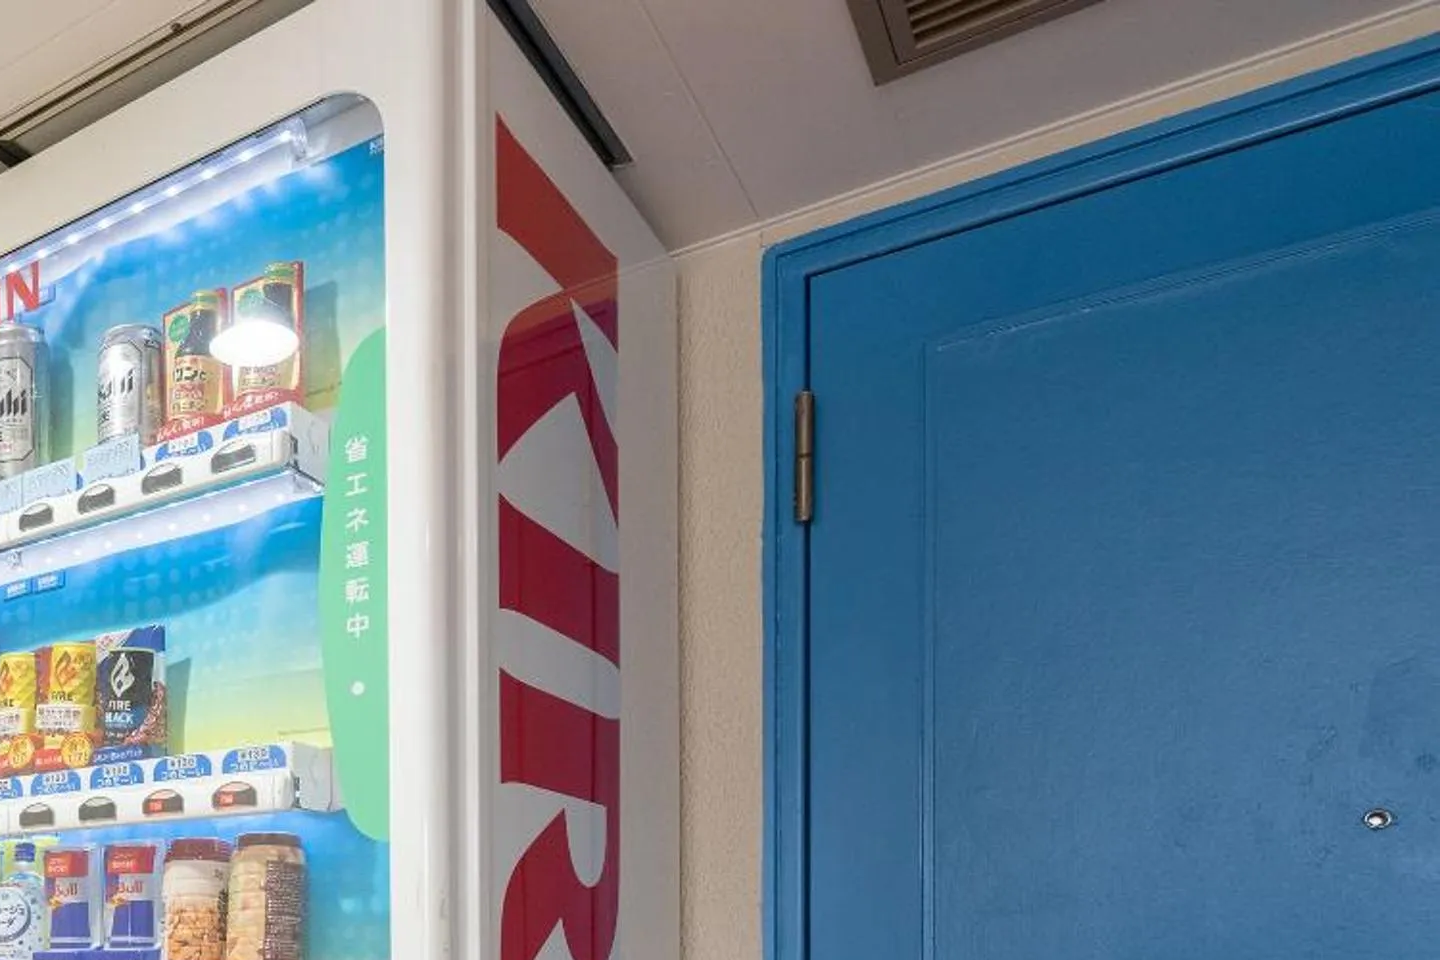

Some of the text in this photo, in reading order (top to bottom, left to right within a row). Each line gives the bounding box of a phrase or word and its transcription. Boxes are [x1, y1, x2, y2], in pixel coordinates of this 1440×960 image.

[343, 435, 369, 639] 省エネ運転中
